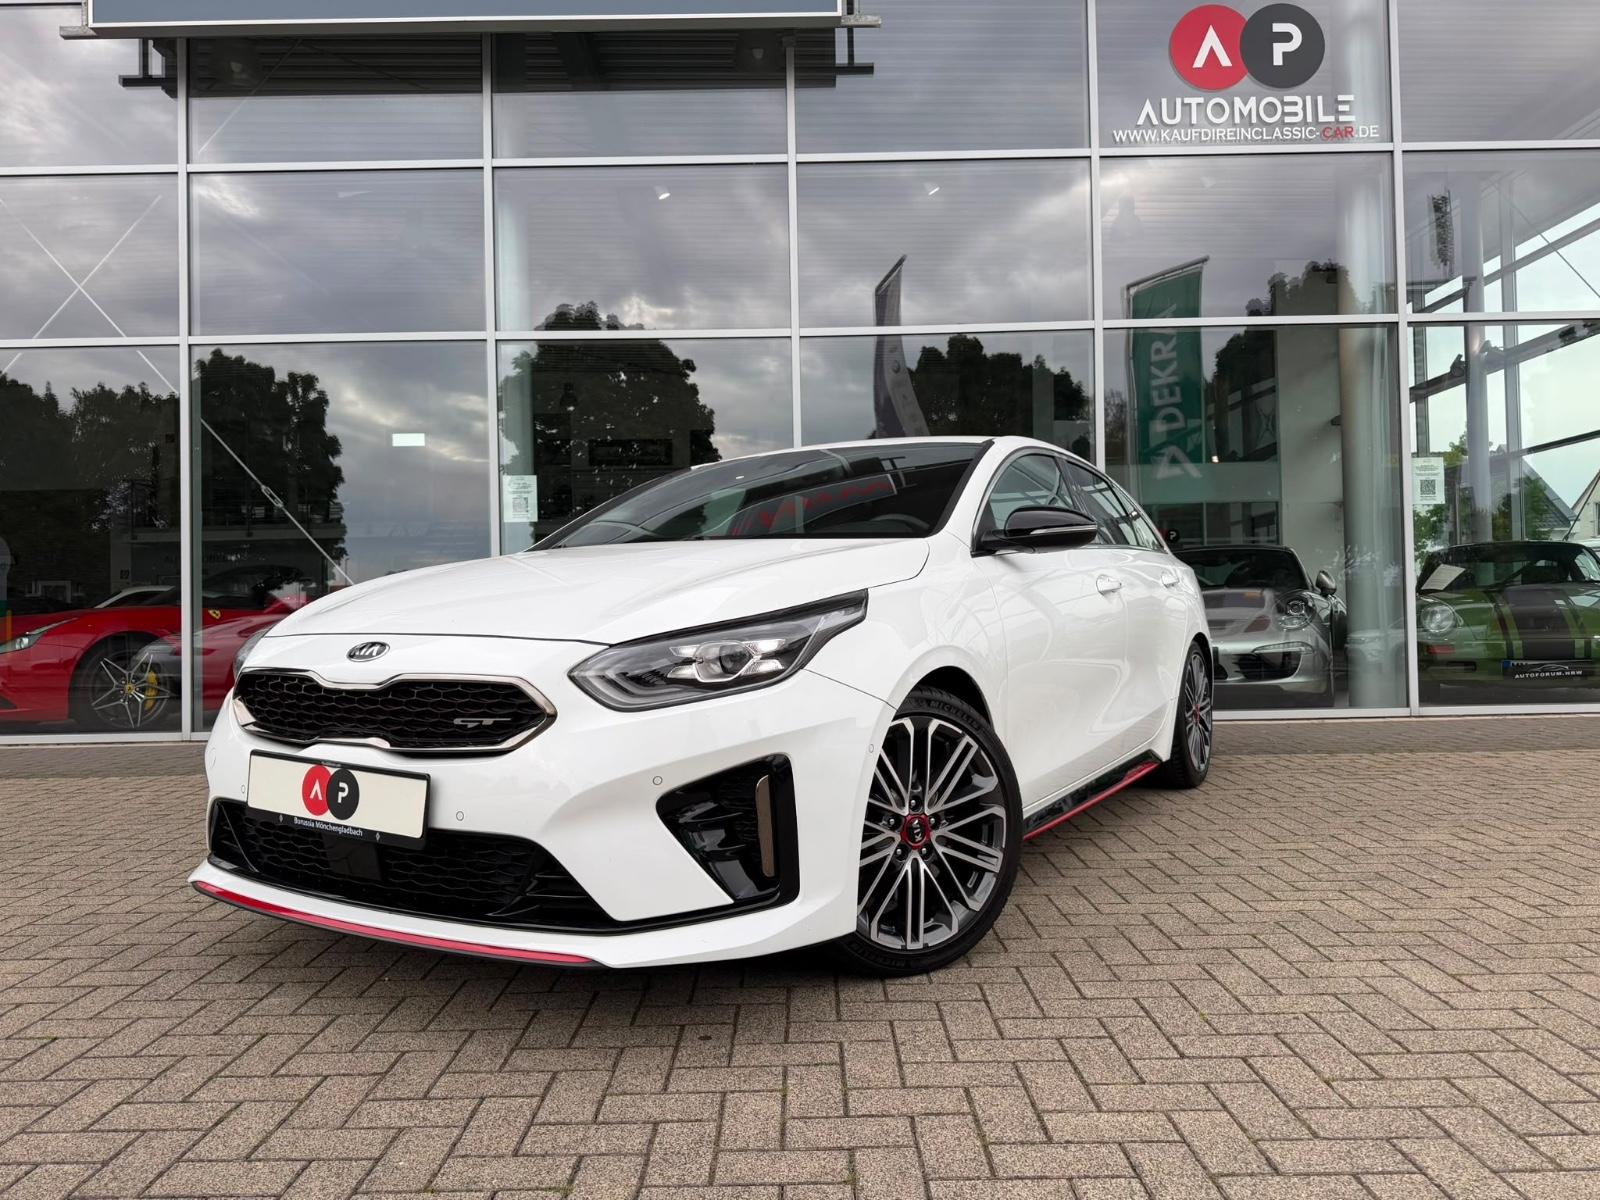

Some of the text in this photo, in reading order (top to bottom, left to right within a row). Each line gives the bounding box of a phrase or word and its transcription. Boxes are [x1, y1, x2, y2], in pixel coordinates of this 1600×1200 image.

[1137, 95, 1356, 125] AUTOMOBILE
[1112, 125, 1380, 143] WWW.KAUFDIREINCLASSIC-CAR.DE
[1150, 303, 1187, 433] DEKRA
[350, 643, 381, 657] KIA
[293, 816, 363, 836] Borussia Mönchengladbach
